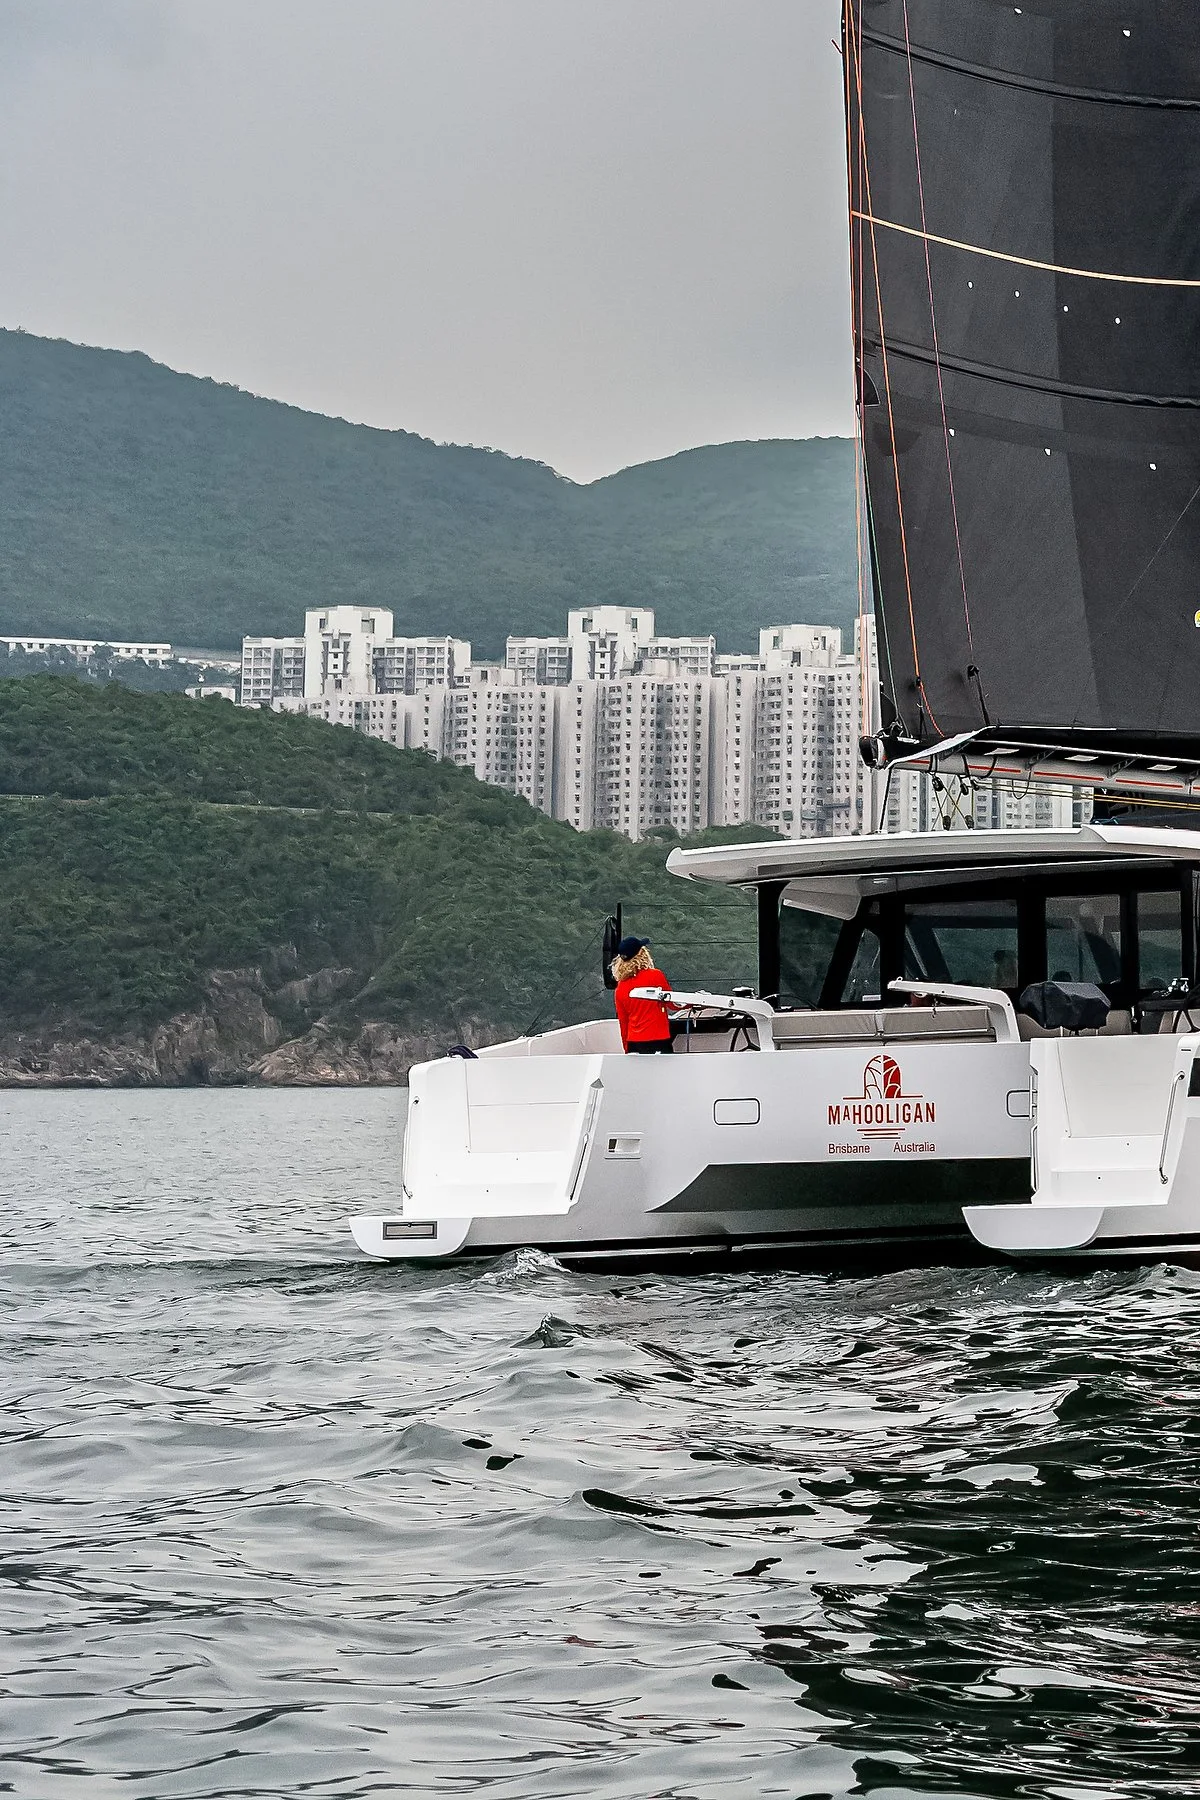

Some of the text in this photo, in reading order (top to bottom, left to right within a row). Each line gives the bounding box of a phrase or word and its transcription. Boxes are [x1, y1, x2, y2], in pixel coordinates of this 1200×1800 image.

[827, 1101, 937, 1126] MAHOOLIGAN
[827, 1140, 936, 1155] Brisbane Australia
